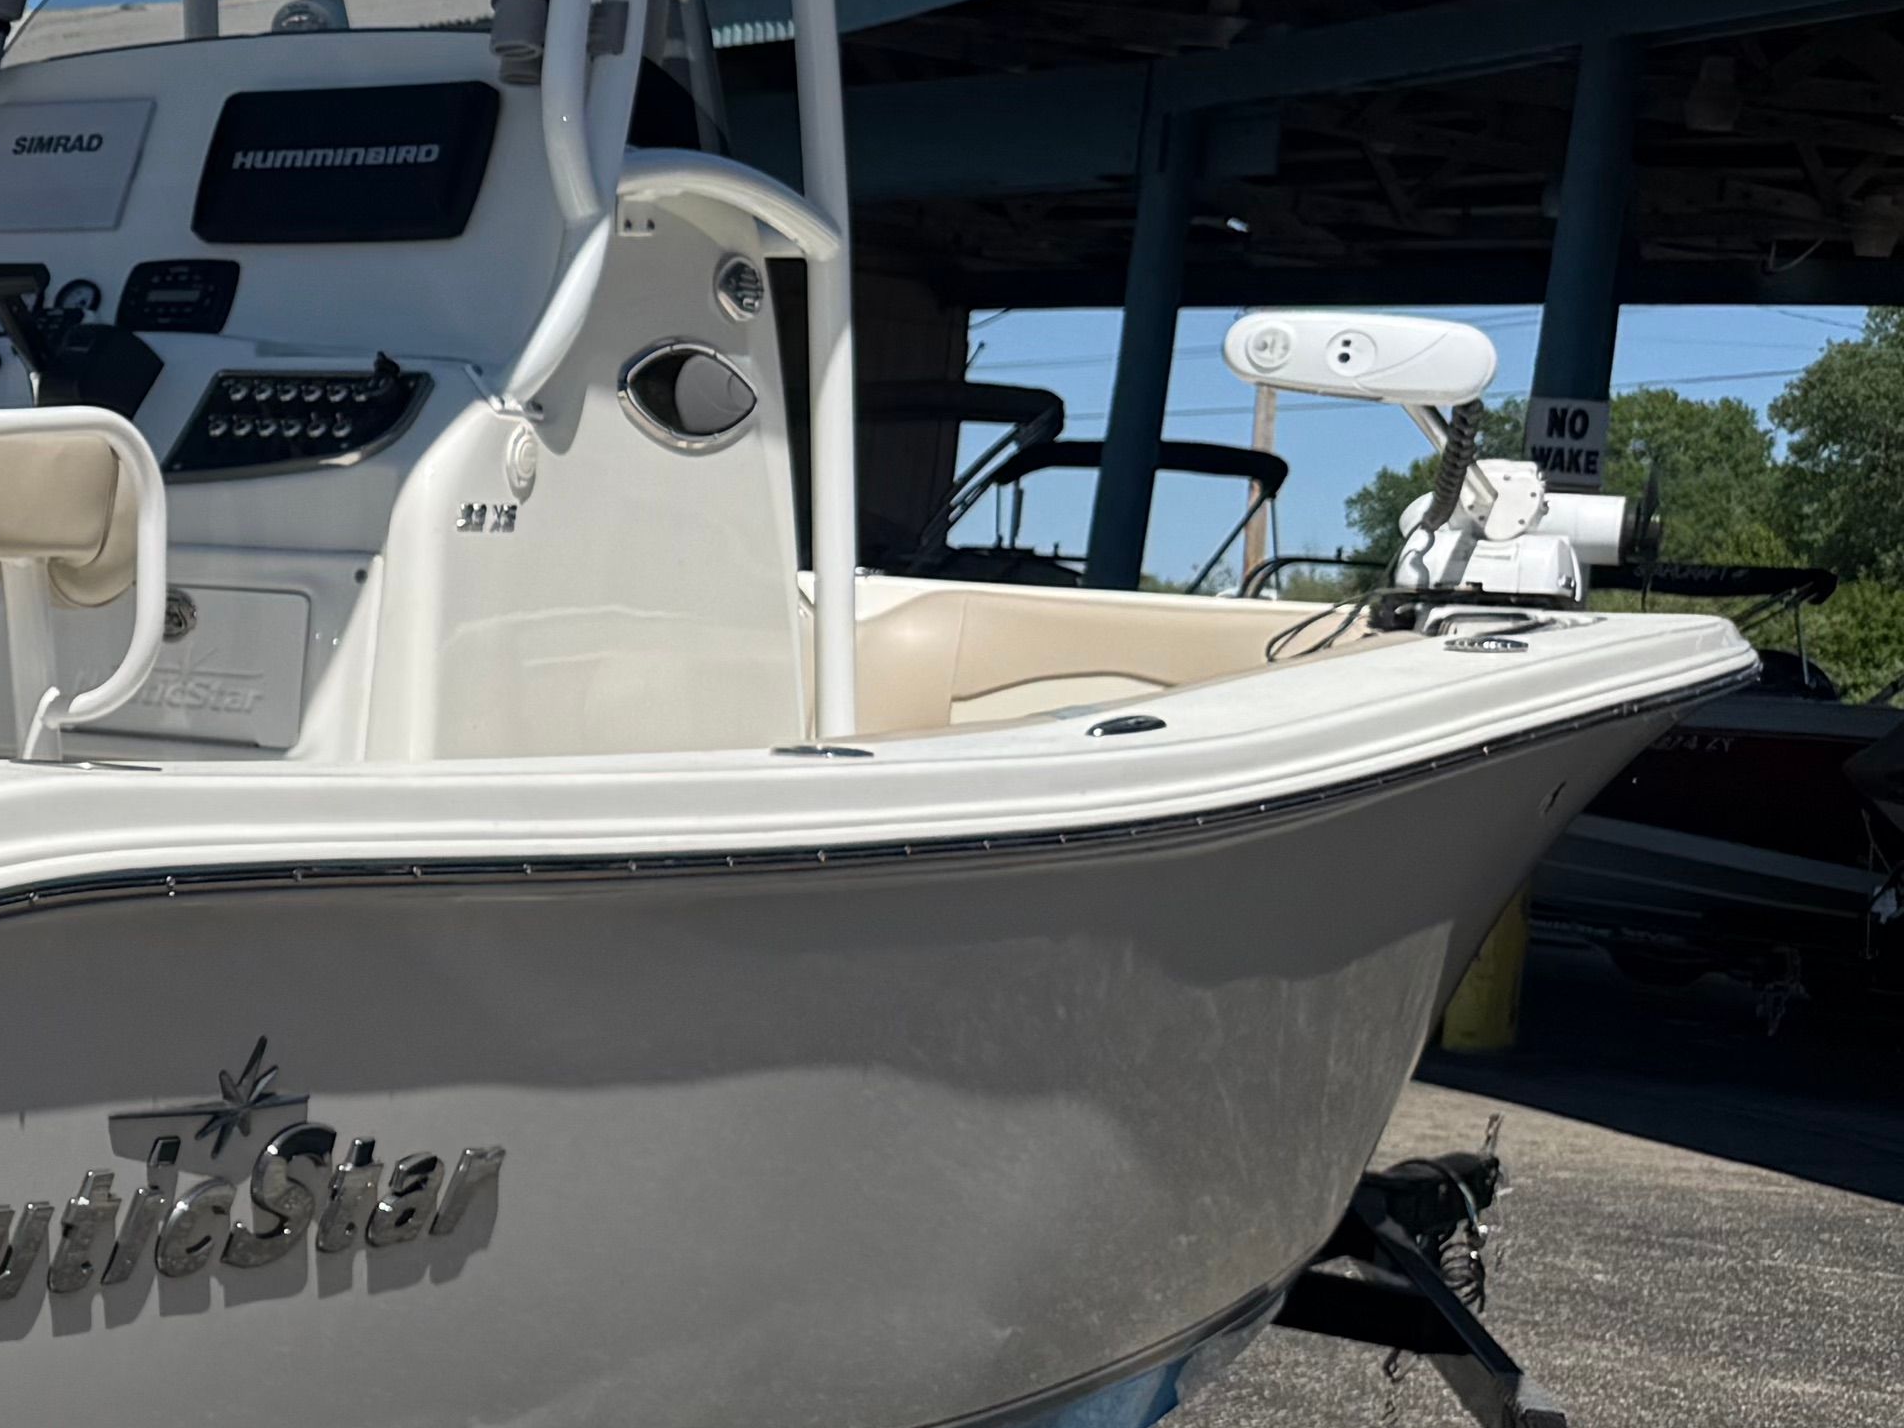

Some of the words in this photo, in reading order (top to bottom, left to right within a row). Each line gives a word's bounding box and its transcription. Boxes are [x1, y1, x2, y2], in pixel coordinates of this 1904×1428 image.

[11, 132, 104, 156] SIMRAD
[232, 143, 440, 172] HUMMINBIRD
[1547, 407, 1590, 441] NO
[1531, 445, 1600, 475] WAKE
